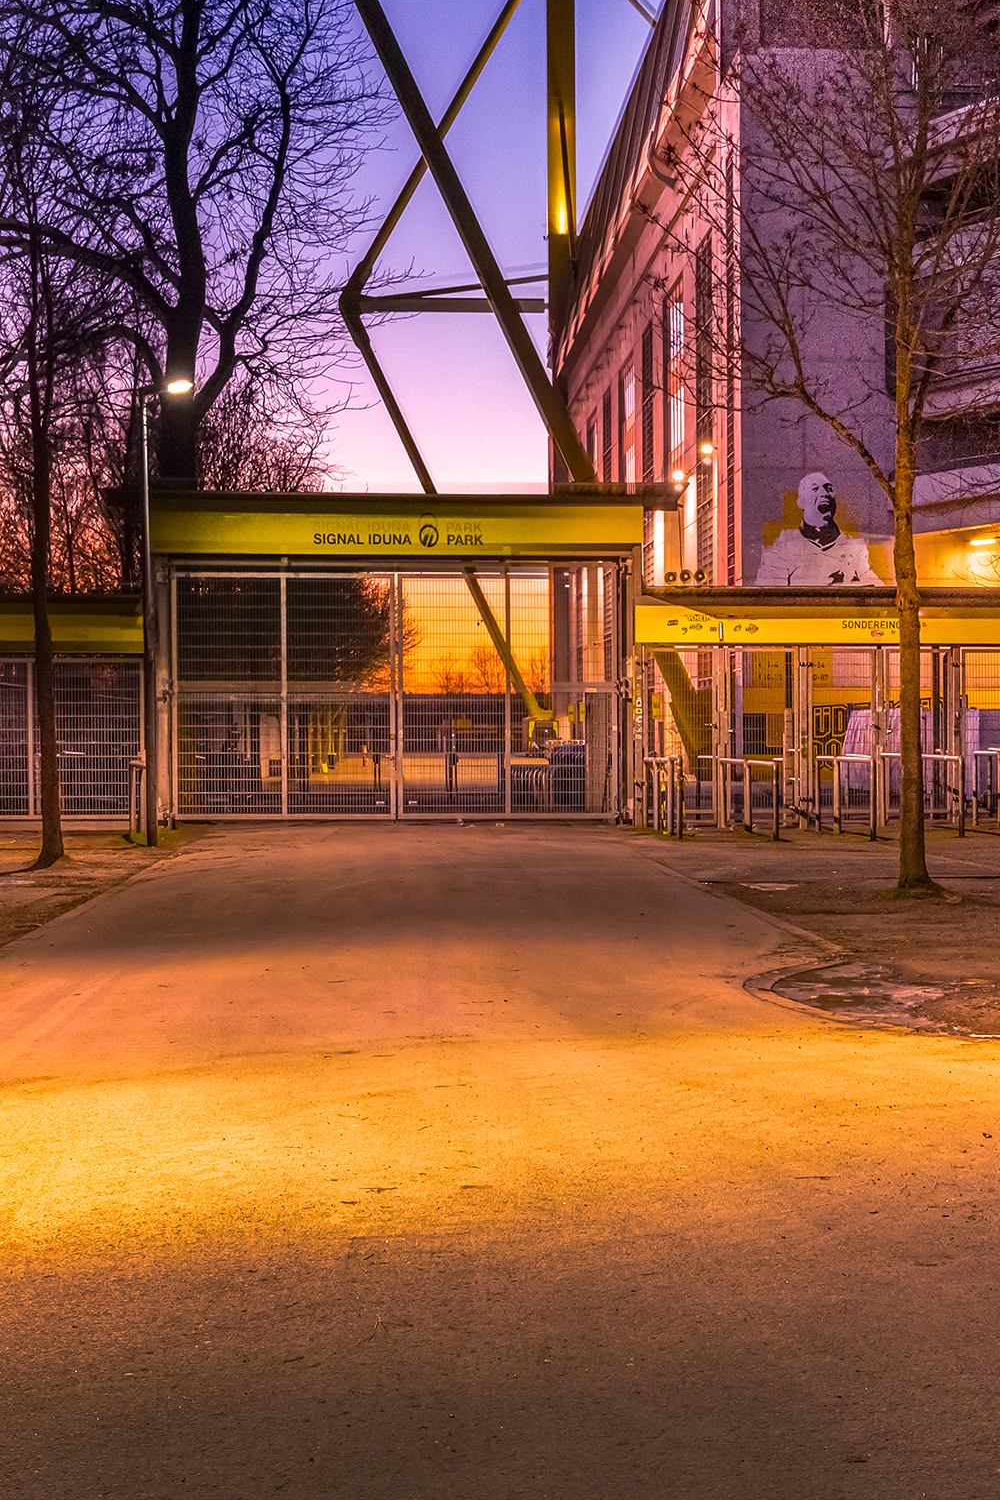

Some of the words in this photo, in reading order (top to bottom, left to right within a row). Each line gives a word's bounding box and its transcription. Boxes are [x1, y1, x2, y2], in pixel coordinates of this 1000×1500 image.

[313, 533, 364, 545] SIGNAL
[368, 534, 412, 545] IDUNA
[447, 534, 483, 545] PARK
